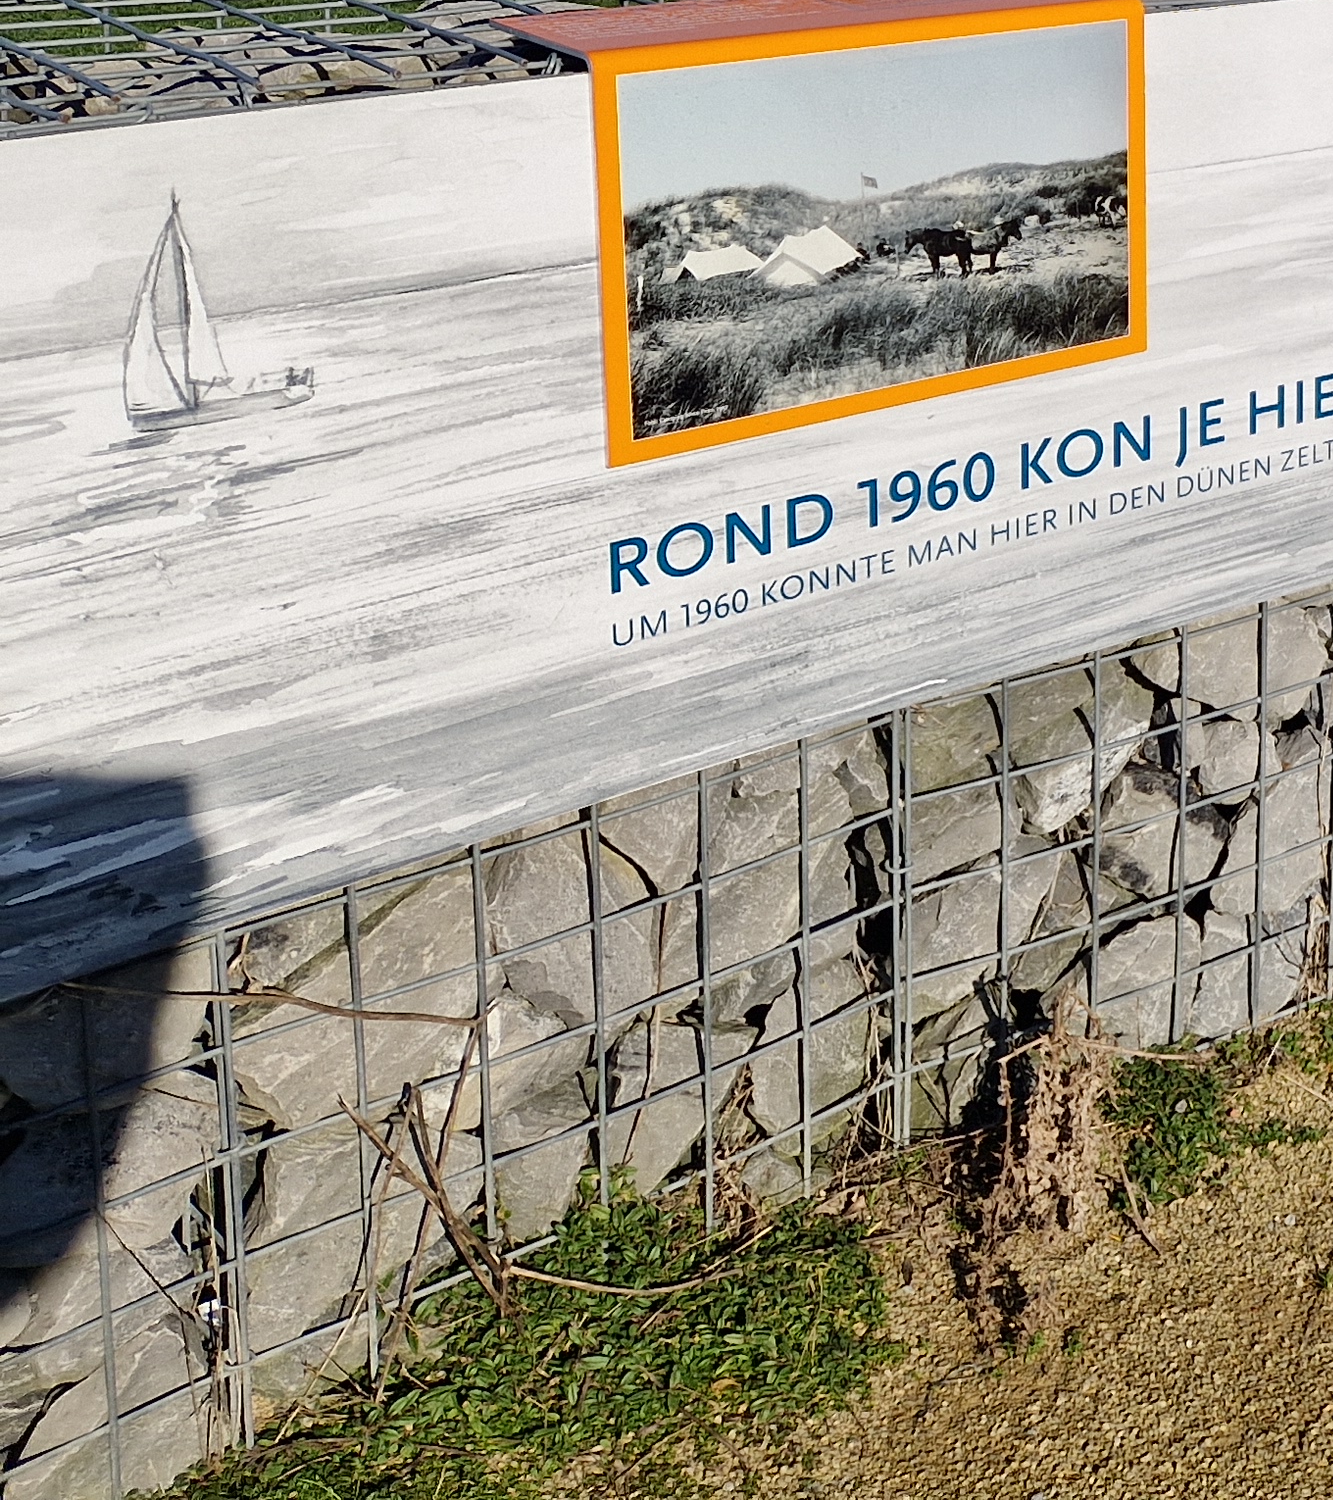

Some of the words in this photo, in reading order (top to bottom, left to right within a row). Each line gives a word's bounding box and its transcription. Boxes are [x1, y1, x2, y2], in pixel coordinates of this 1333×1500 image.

[610, 493, 834, 595] ROND
[856, 451, 996, 528] 1960
[1020, 414, 1151, 490] KON
[1174, 398, 1226, 468] JE
[611, 609, 667, 648] UM
[680, 587, 749, 629] 1960
[761, 549, 897, 607] KONNTE
[907, 529, 978, 566] MAN
[990, 508, 1058, 546] HIER
[1068, 498, 1097, 526] IN
[1109, 484, 1165, 517] DEN
[1176, 453, 1271, 499] DÜNEN
